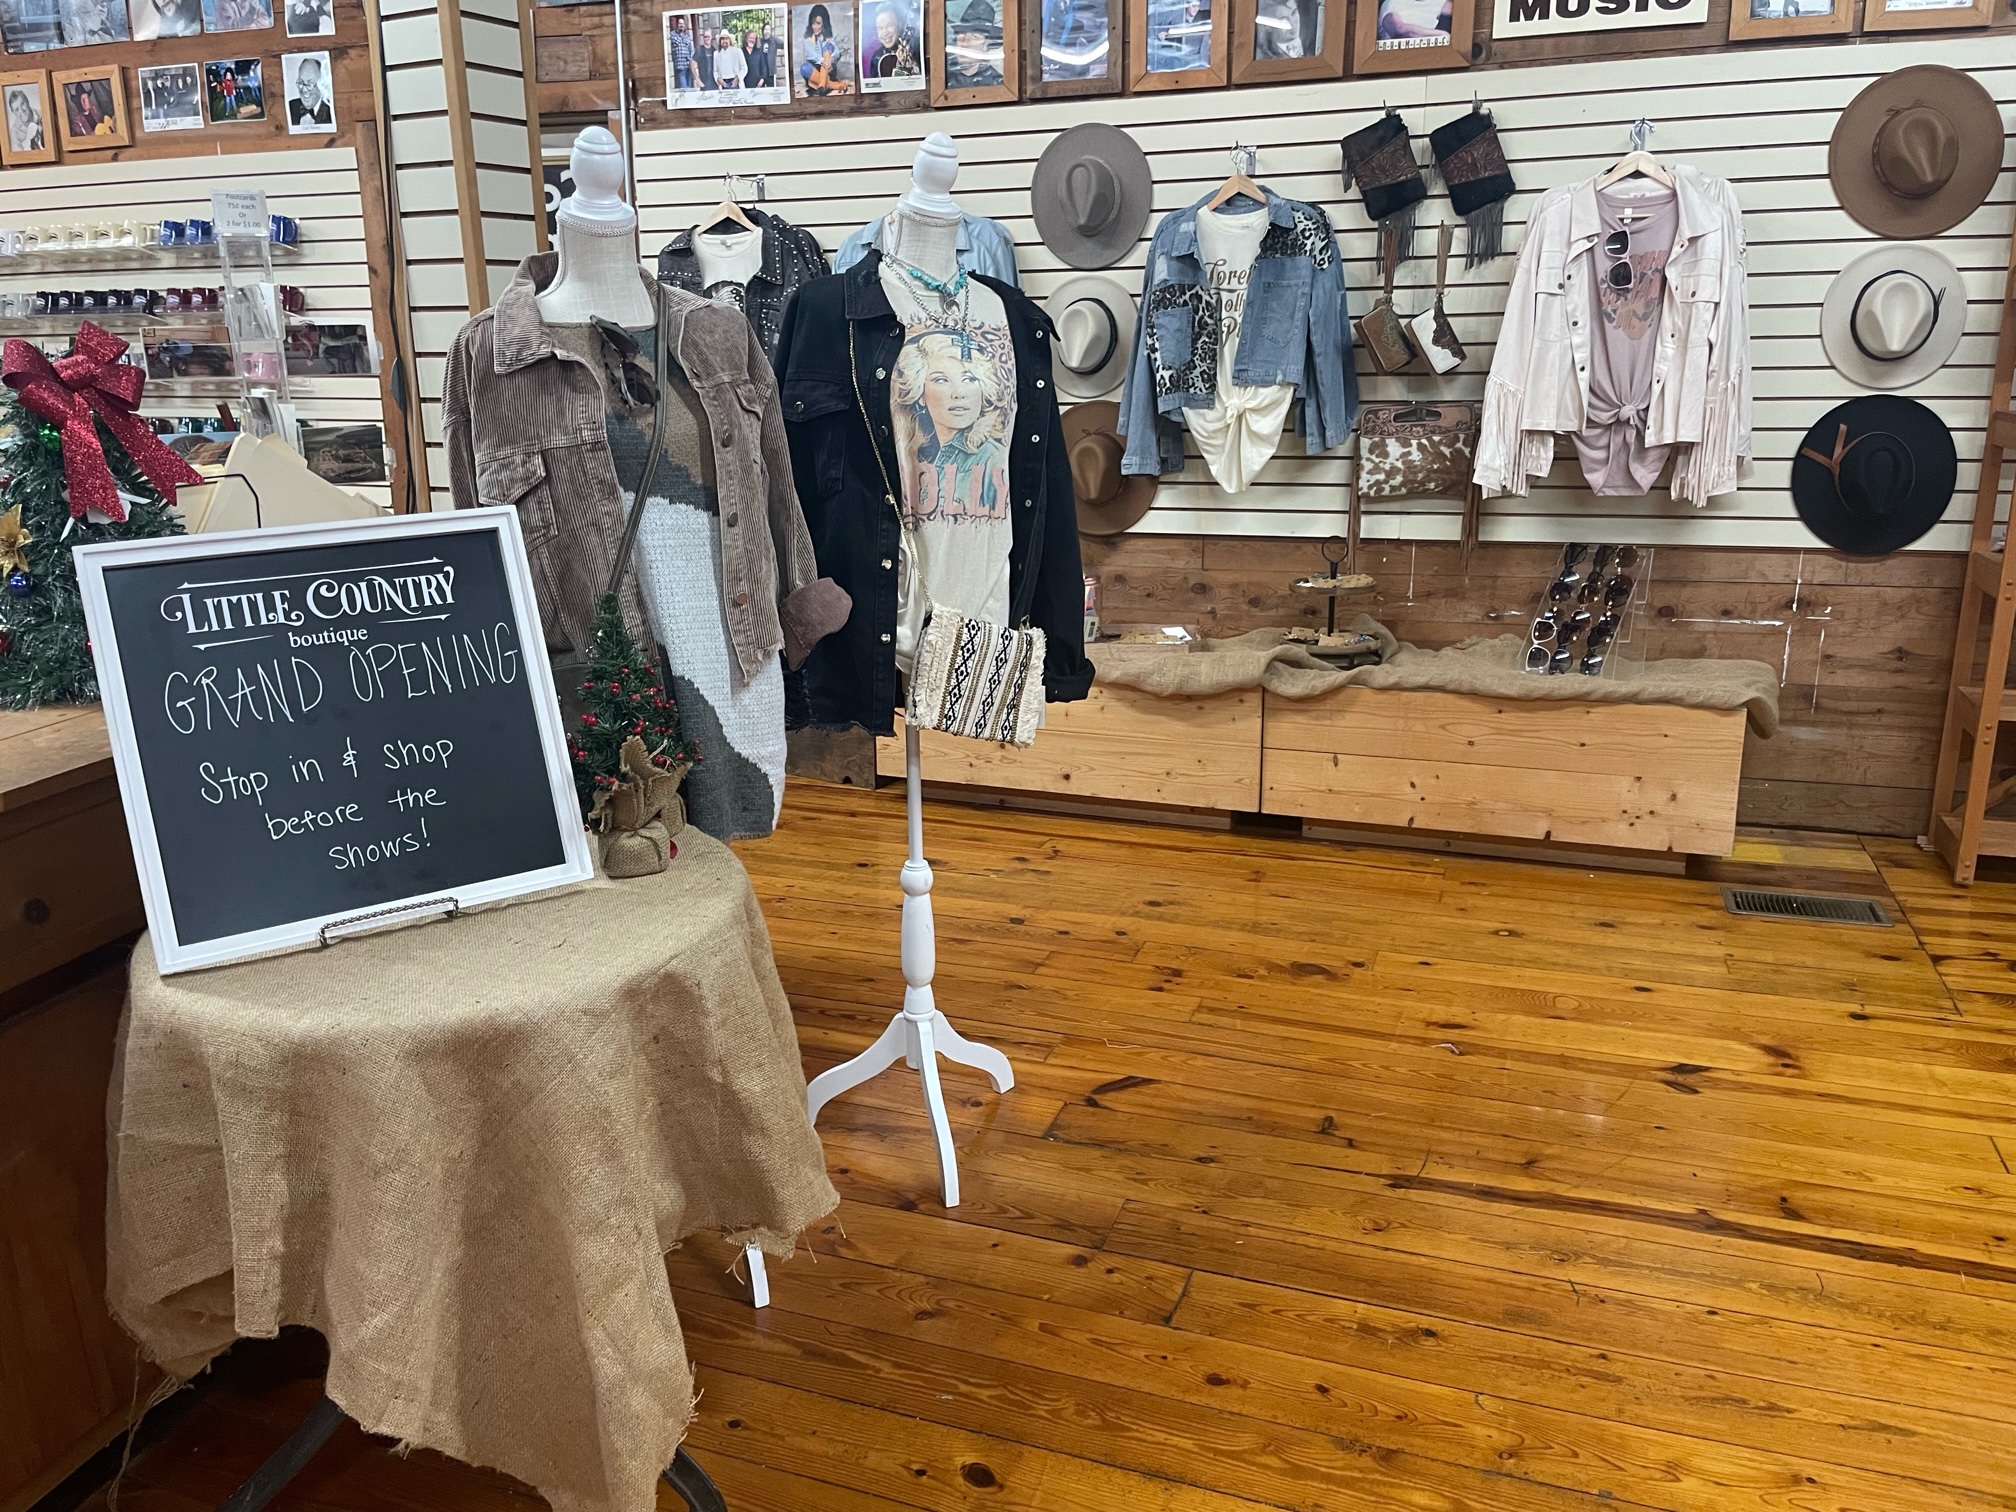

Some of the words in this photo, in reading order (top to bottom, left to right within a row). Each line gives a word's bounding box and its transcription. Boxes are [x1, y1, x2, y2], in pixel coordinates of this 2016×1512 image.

[288, 627, 369, 649] boutique
[164, 656, 323, 735] GRAND
[349, 622, 518, 702] OPENING
[199, 762, 269, 806] Stop
[288, 755, 324, 783] in
[342, 736, 358, 778] &
[265, 803, 364, 840] before
[388, 788, 447, 812] the
